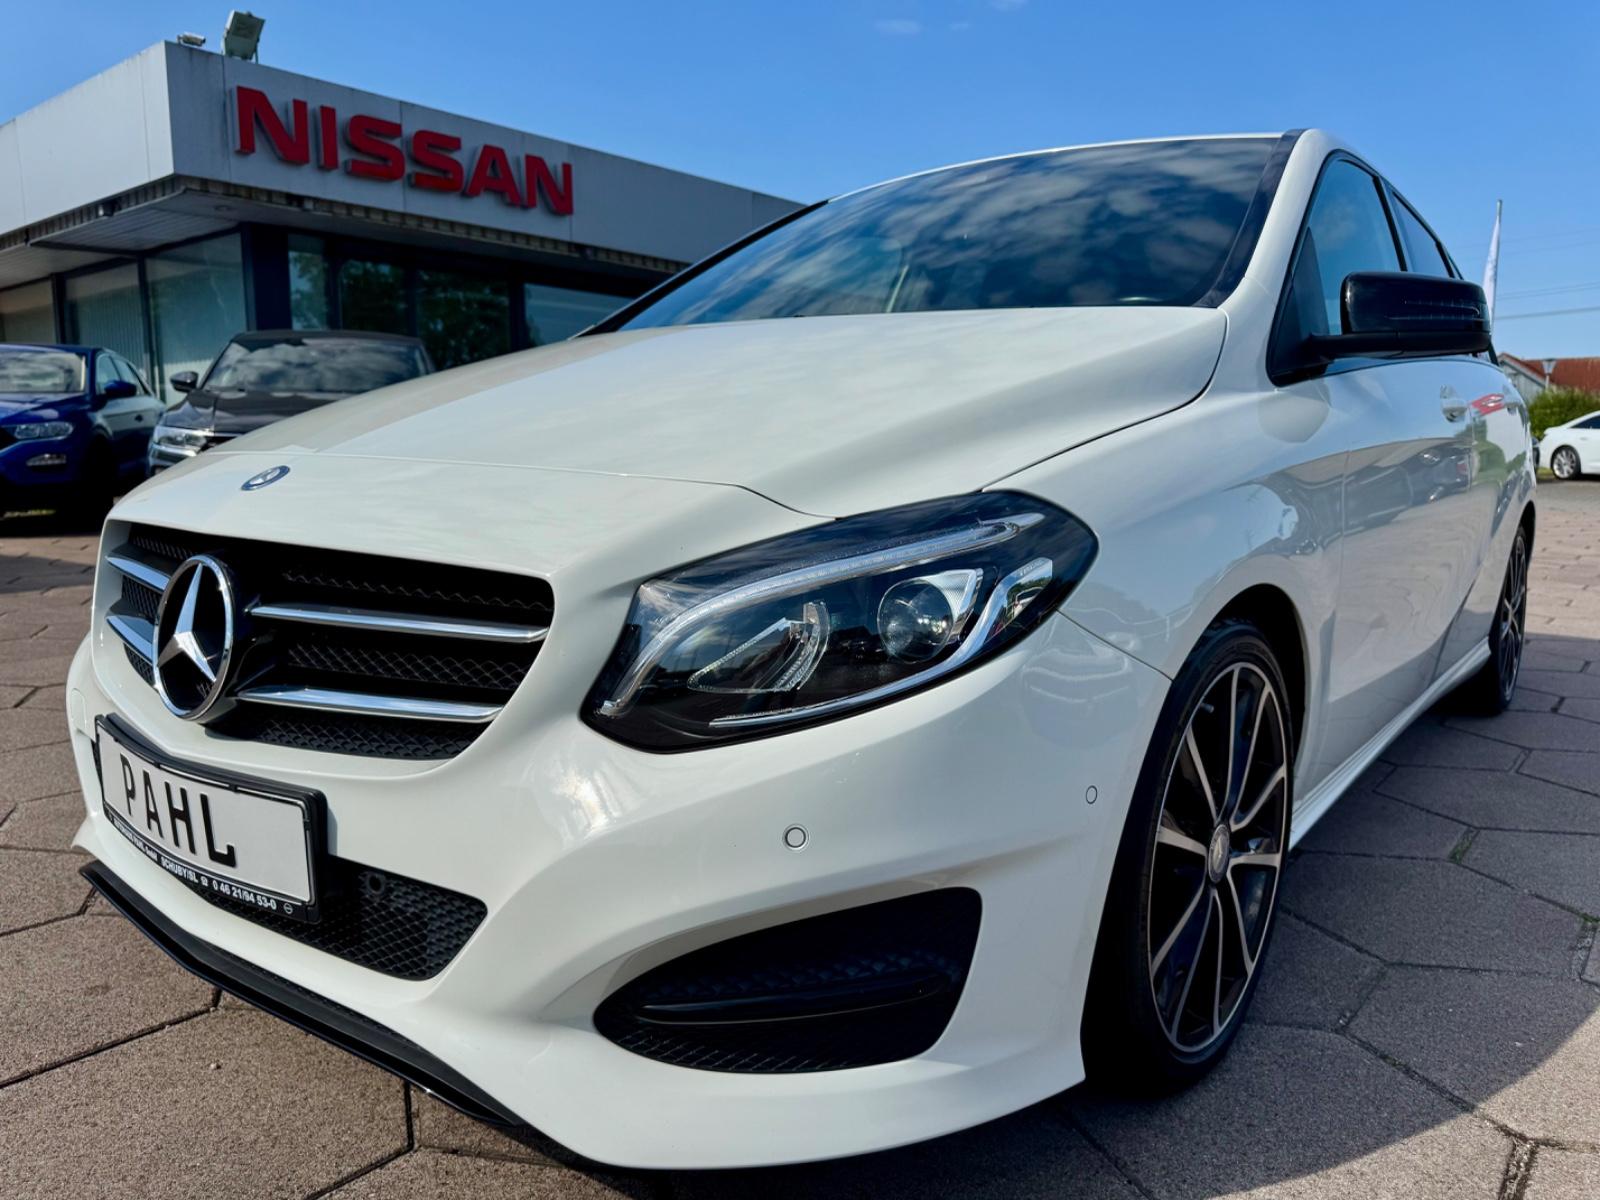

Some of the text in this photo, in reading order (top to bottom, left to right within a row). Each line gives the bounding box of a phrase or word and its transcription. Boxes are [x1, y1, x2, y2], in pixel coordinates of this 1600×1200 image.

[236, 85, 573, 216] NISSAN
[120, 752, 236, 868] PAHL
[256, 895, 277, 910] 53-0
